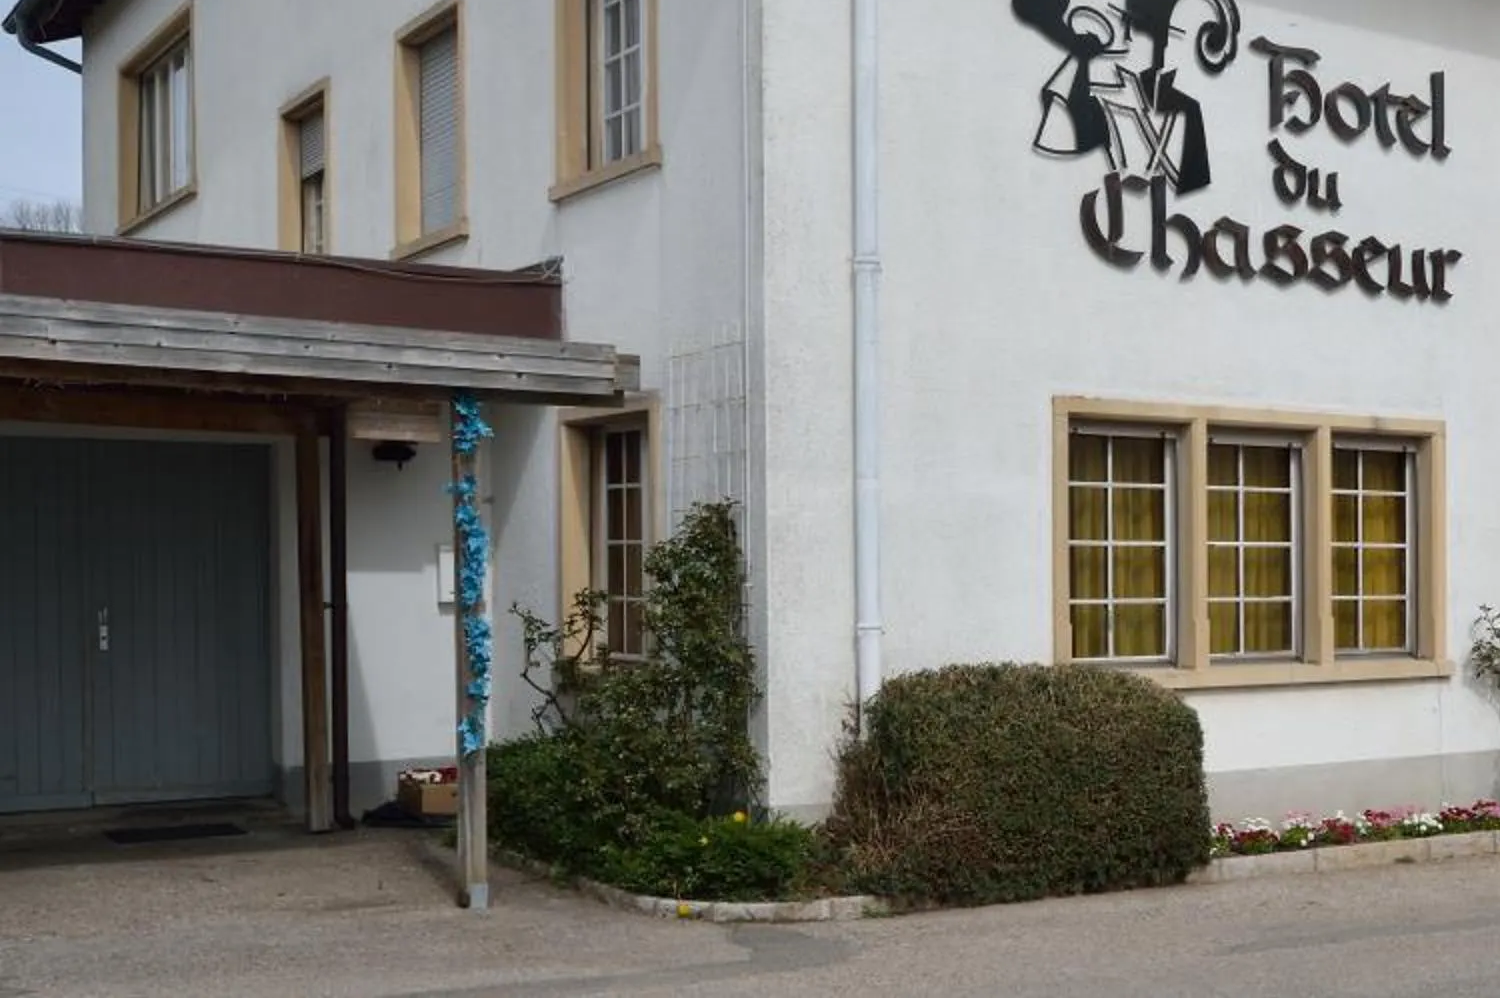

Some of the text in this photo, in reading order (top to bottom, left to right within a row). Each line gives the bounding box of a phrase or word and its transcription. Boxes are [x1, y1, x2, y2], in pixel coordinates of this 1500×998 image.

[1250, 36, 1451, 161] Hotel
[1079, 170, 1463, 305] Chasseur
[1267, 138, 1343, 212] du
